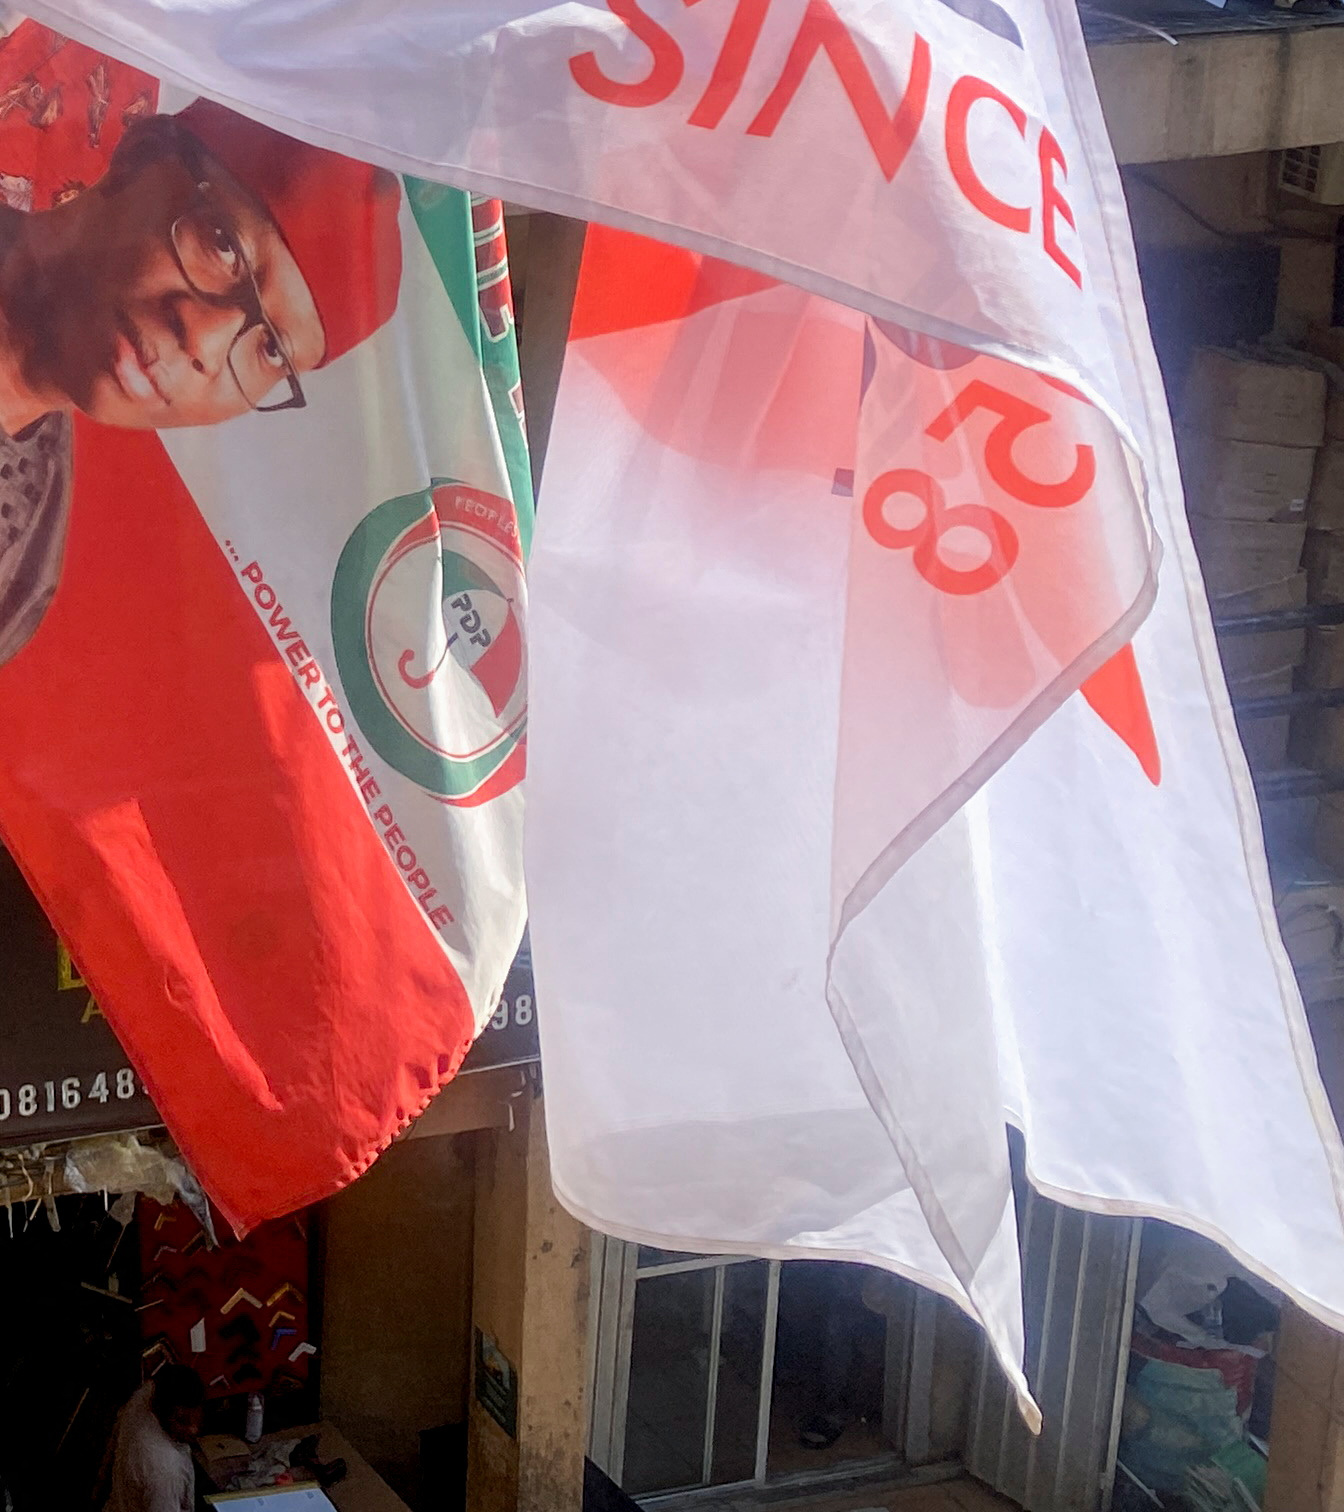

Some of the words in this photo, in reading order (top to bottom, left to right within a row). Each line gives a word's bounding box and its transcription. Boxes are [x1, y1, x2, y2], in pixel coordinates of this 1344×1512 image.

[451, 593, 492, 648] PDP
[240, 560, 323, 691] POWER
[317, 685, 346, 736] TO
[341, 734, 382, 807] THE
[373, 803, 455, 931] PEOPLE
